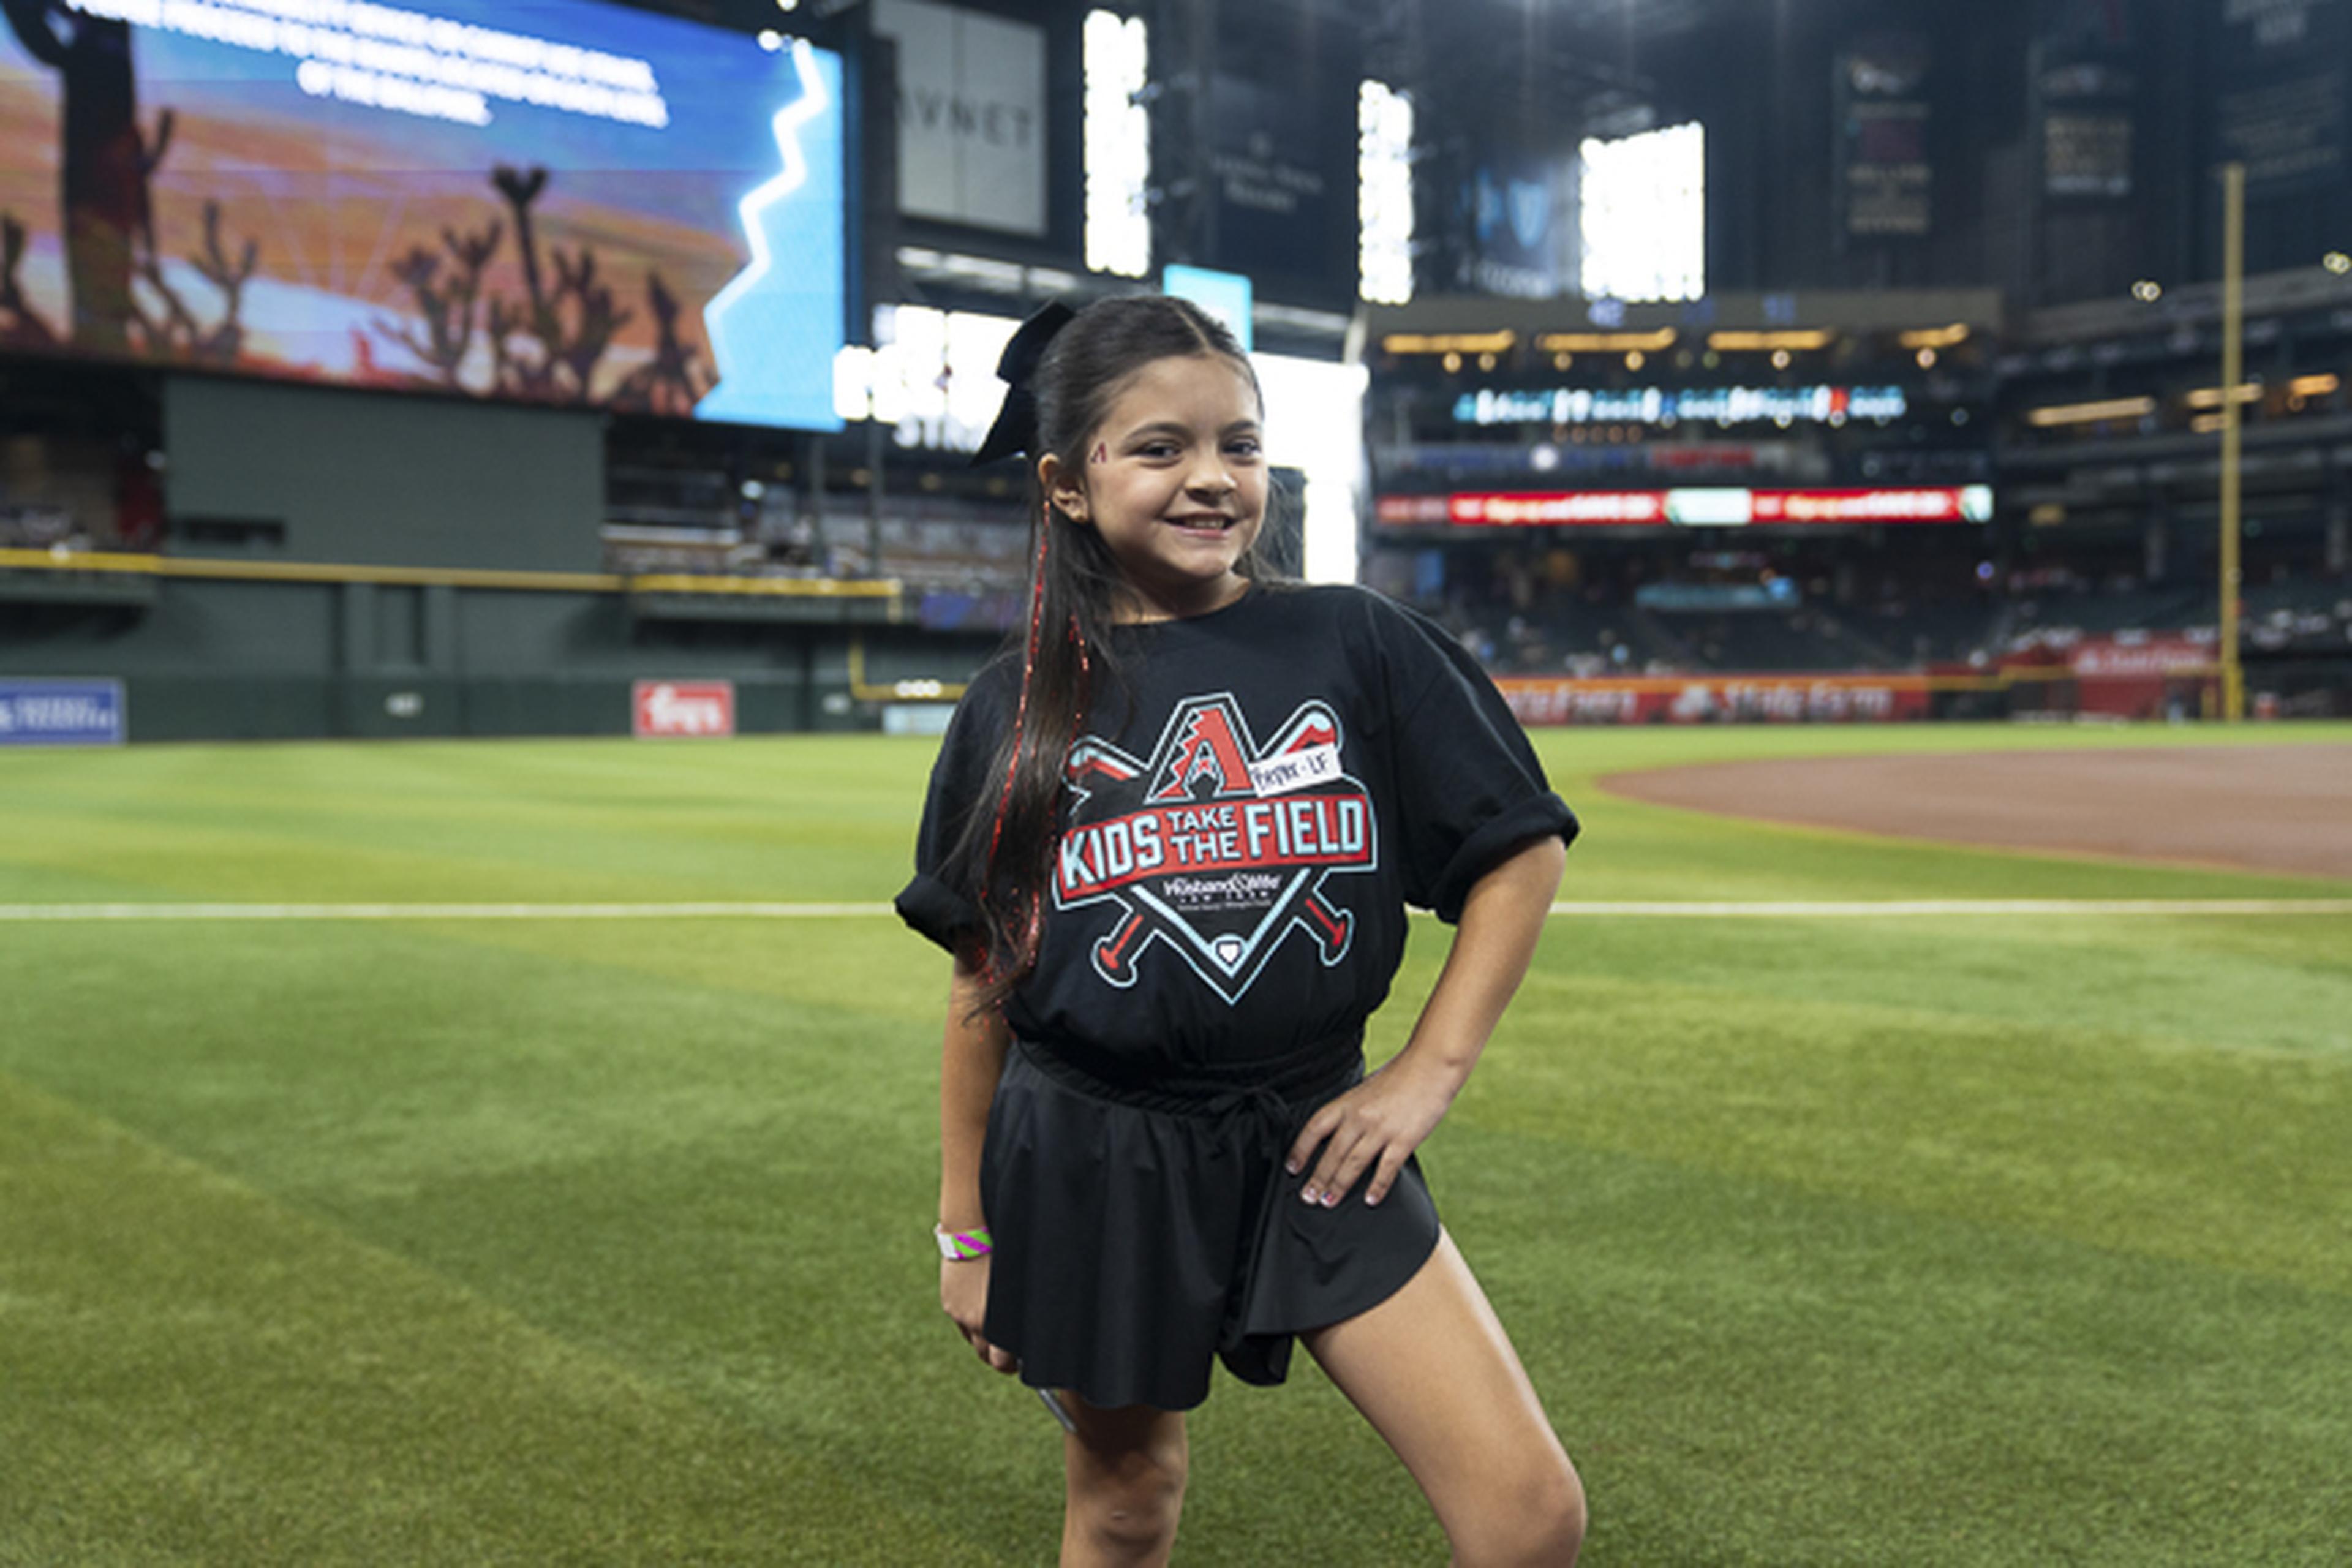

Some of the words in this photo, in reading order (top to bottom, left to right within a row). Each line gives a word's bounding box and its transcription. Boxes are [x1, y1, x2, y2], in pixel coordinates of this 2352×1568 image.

[1166, 806, 1238, 834] TAKE
[1244, 799, 1364, 859] FIELD
[1061, 813, 1164, 890] KIDS
[1169, 831, 1243, 864] THE
